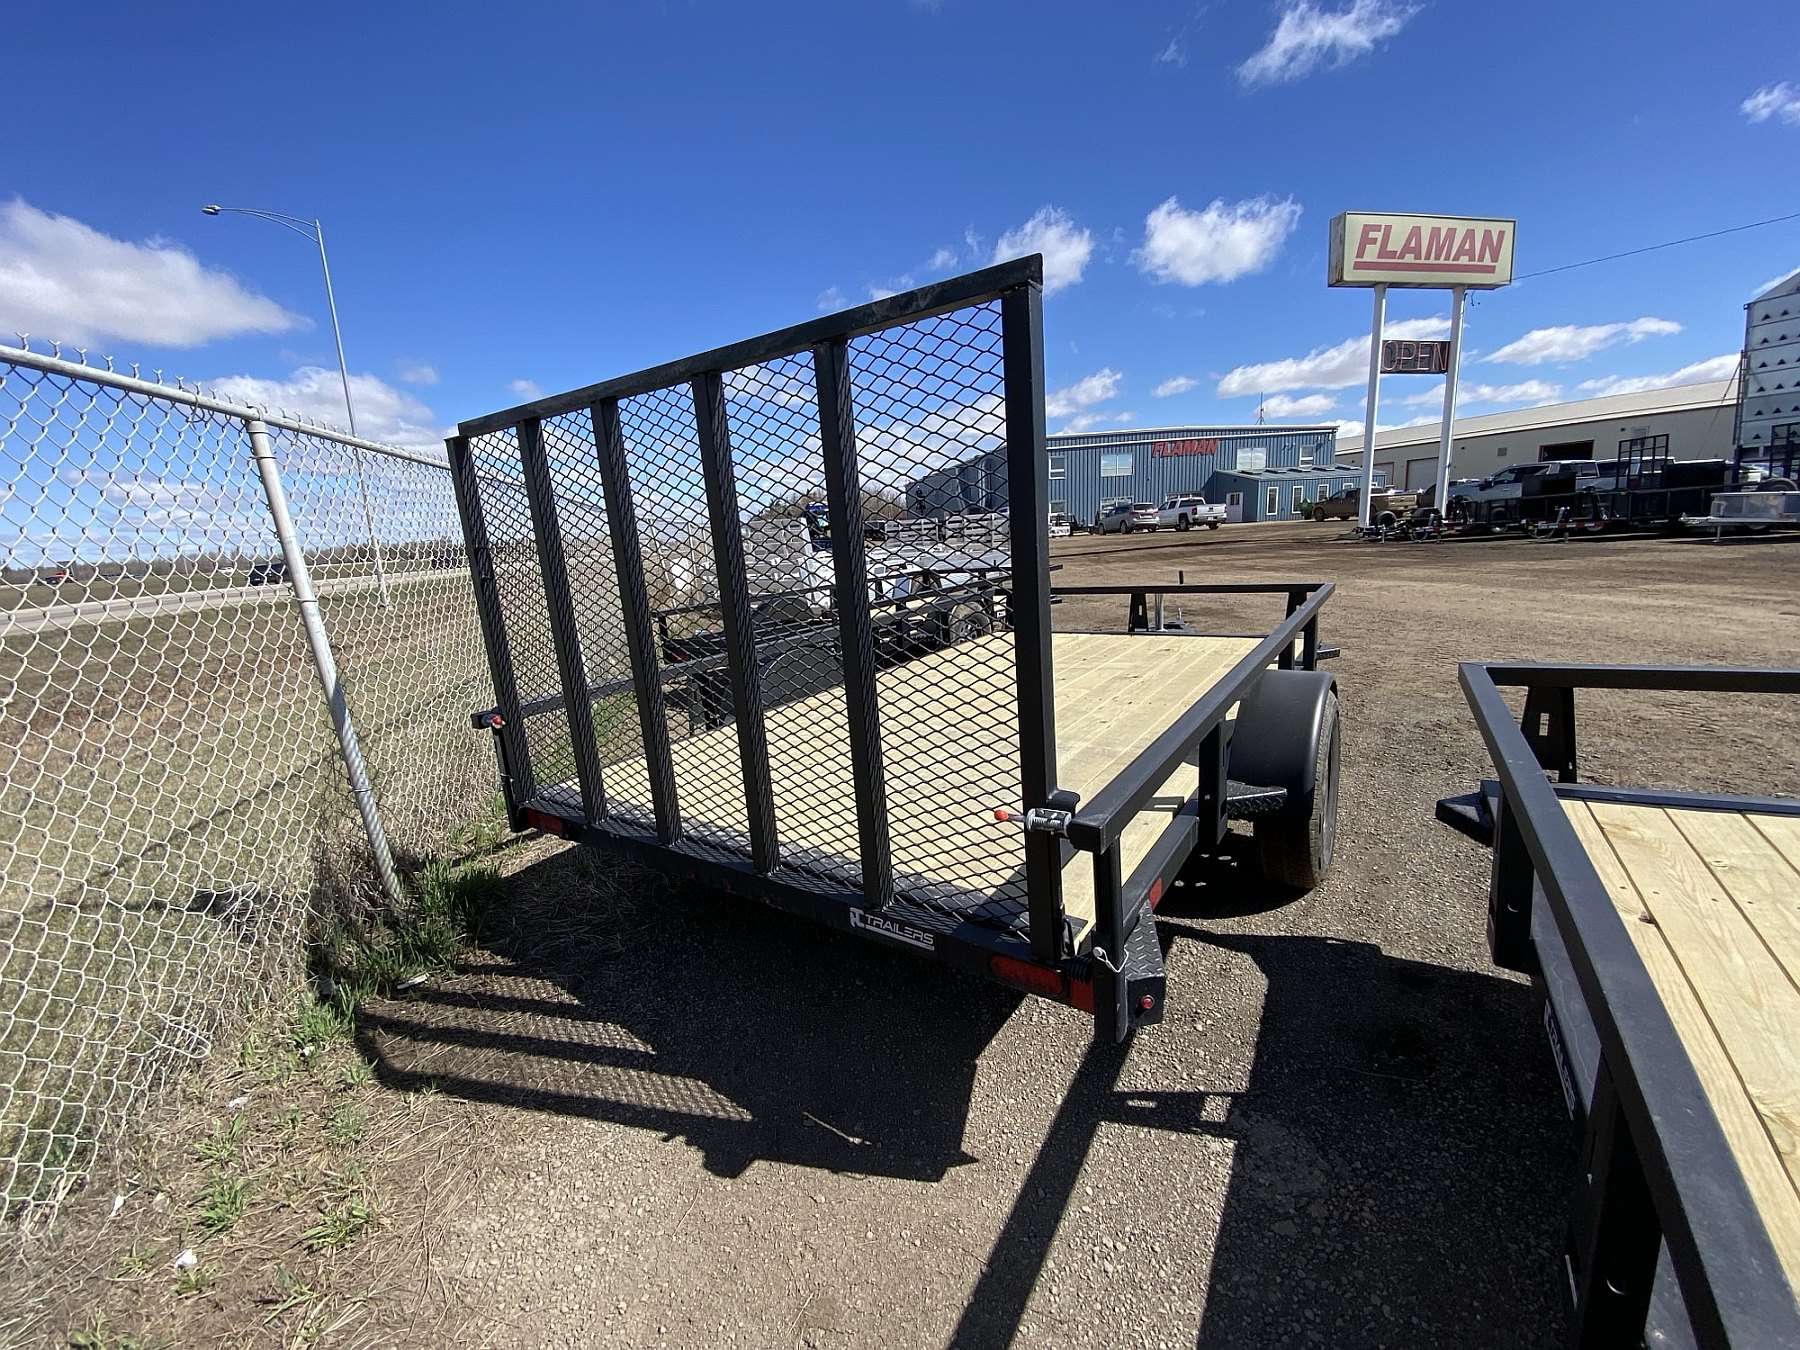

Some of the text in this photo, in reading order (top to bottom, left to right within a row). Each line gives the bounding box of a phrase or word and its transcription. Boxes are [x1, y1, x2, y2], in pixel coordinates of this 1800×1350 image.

[1355, 223, 1506, 264] FLAMAN
[1382, 340, 1449, 371] OPEN
[1152, 438, 1218, 457] FLAMAN
[864, 914, 934, 945] TRAILERS
